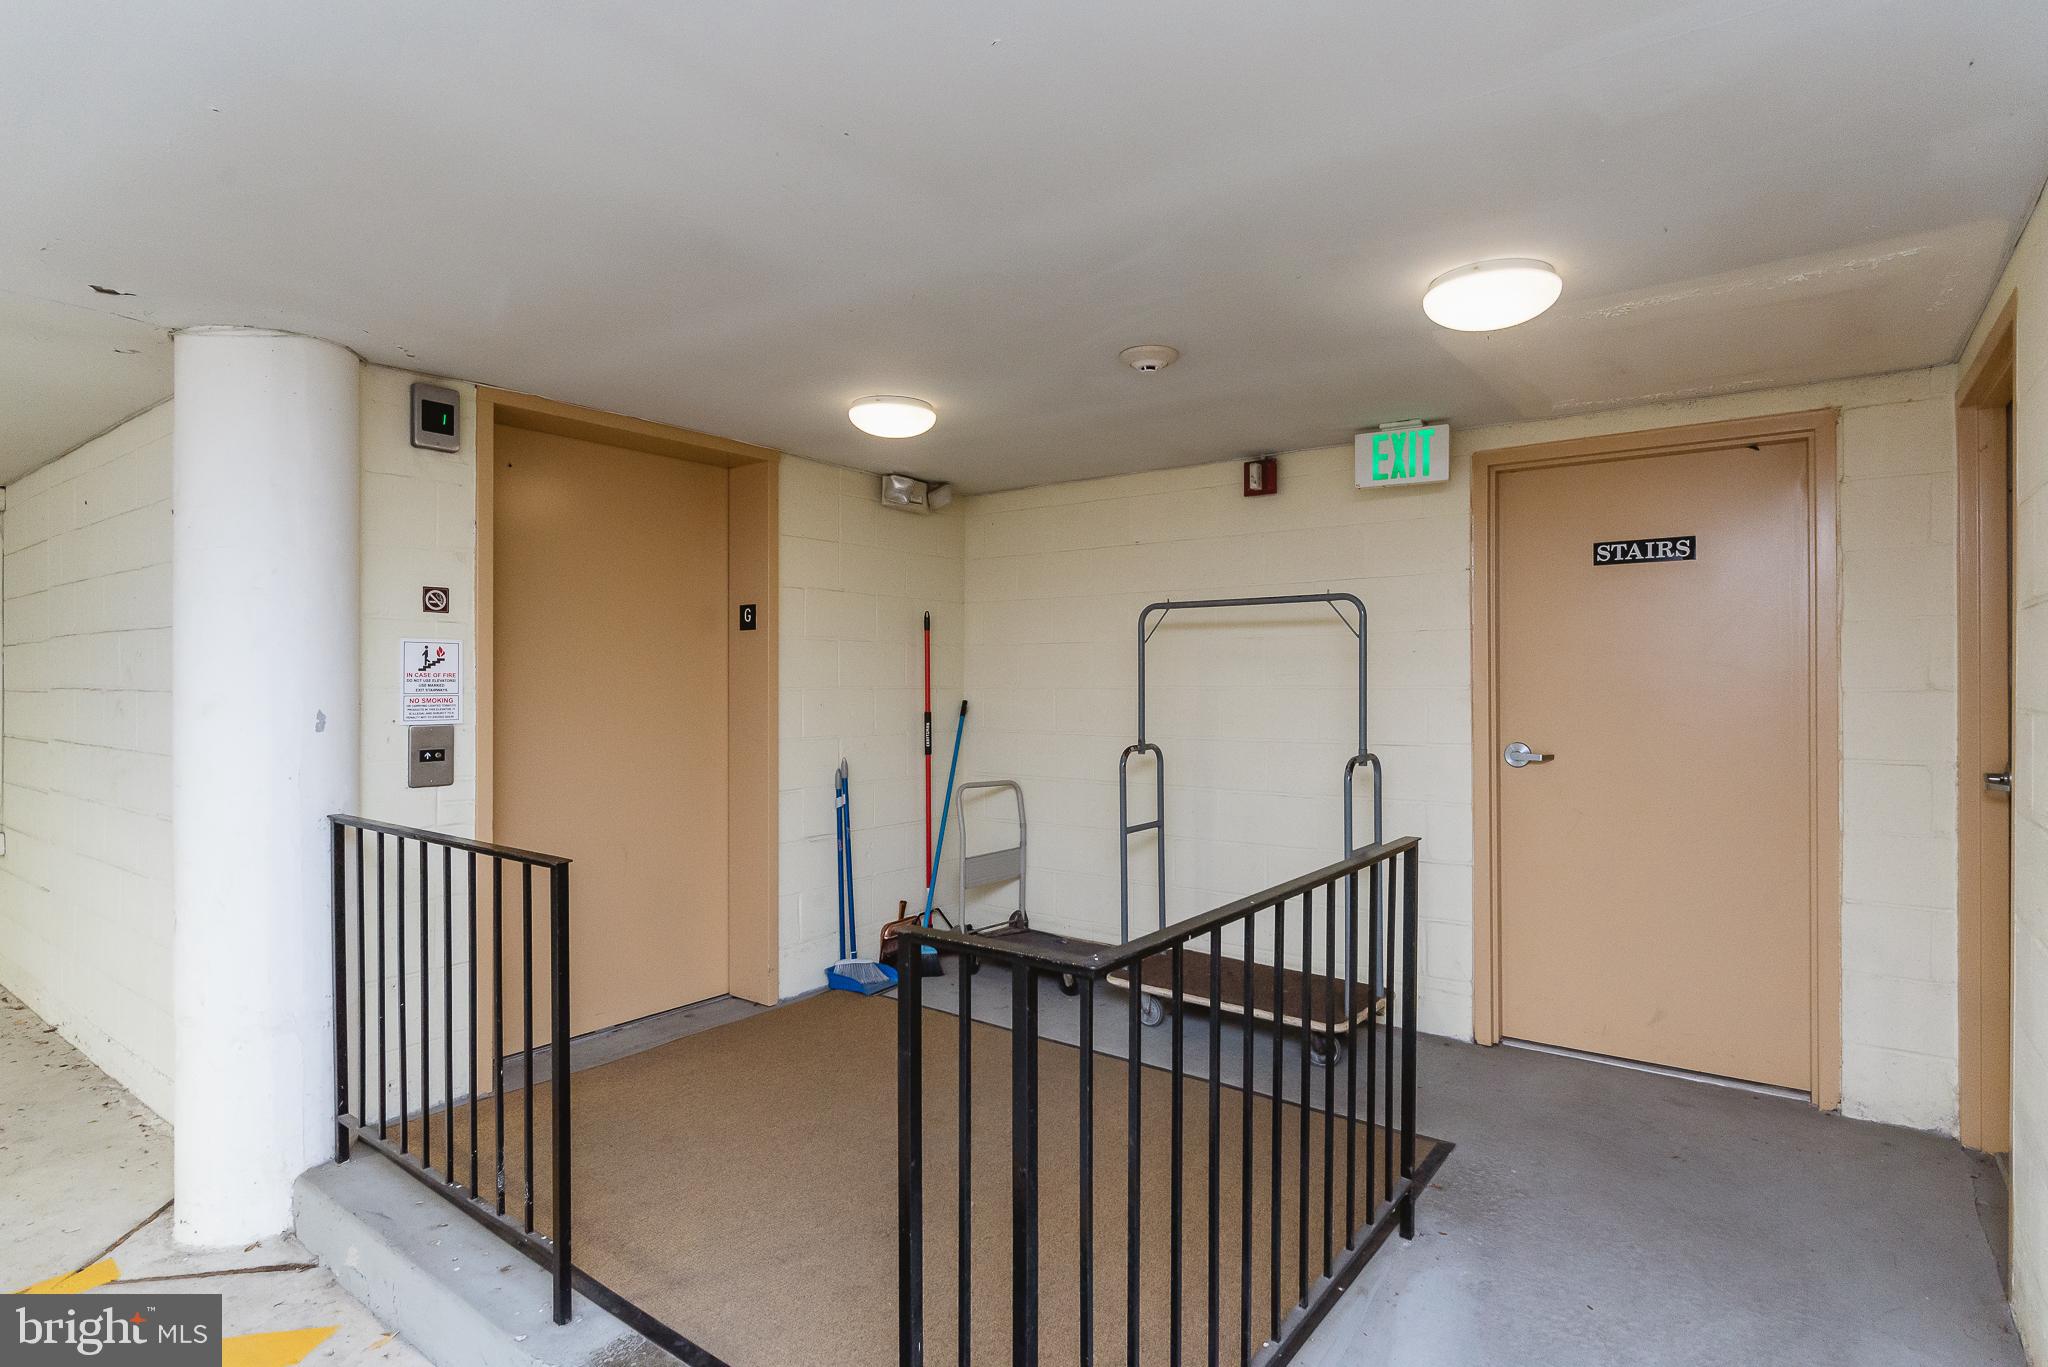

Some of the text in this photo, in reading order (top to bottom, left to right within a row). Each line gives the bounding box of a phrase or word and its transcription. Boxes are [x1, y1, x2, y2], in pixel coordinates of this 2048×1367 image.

[1372, 428, 1436, 480] EXIT
[1596, 539, 1691, 562] STAIRS
[744, 608, 752, 622] G
